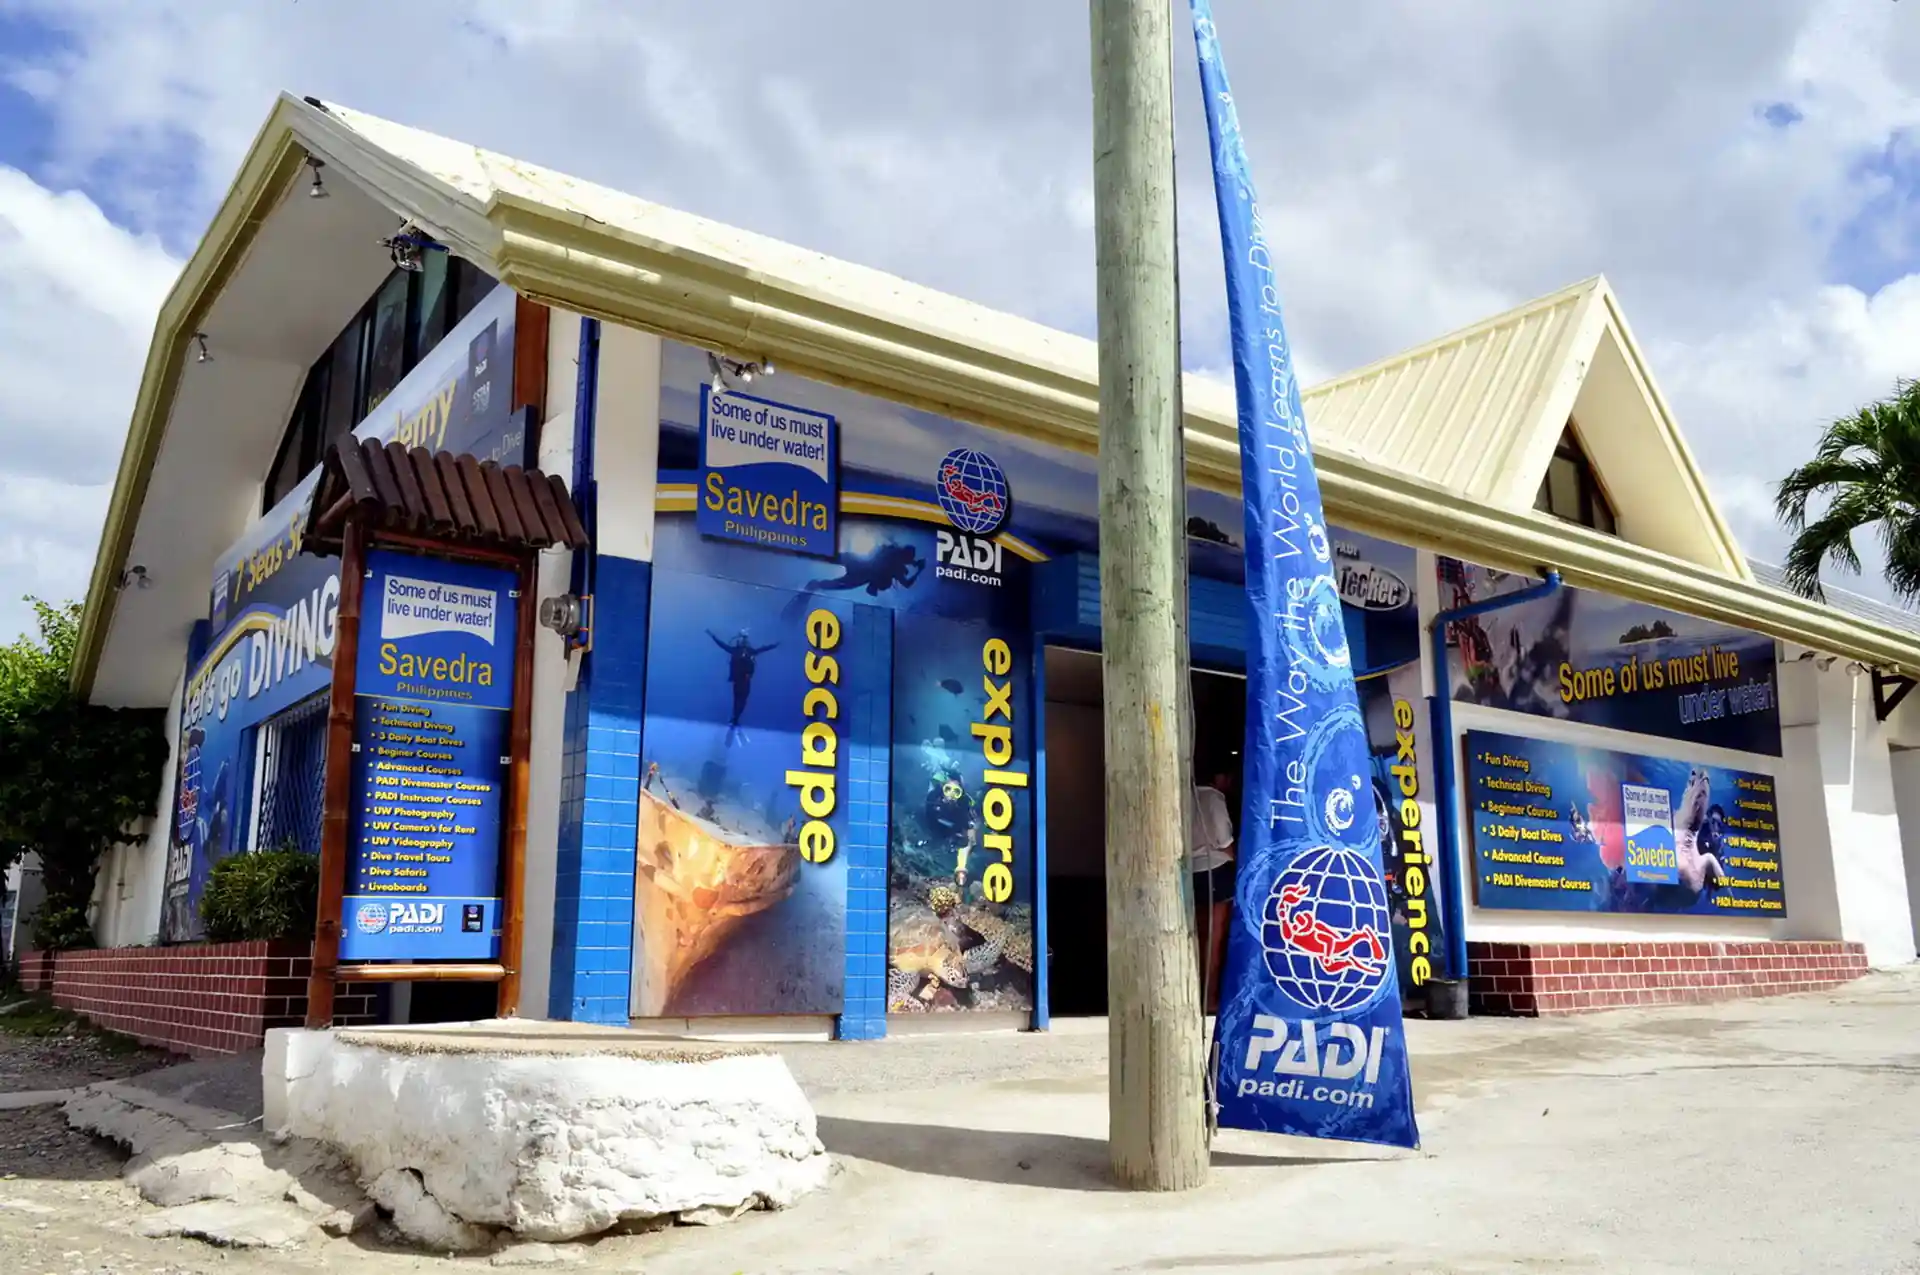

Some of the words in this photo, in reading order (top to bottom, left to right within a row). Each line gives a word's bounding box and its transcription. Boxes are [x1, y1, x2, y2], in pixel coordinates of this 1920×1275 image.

[1260, 285, 1281, 316] to
[1265, 327, 1292, 433] Learns
[712, 396, 751, 422] Some
[754, 408, 769, 426] of
[770, 415, 787, 430] us
[790, 418, 824, 439] must
[712, 418, 736, 442] live
[740, 430, 780, 452] under
[783, 442, 825, 460] water!
[705, 472, 828, 531] Savedra
[1266, 443, 1303, 560] World
[725, 520, 807, 546] Philippines
[936, 530, 1002, 573] PADI
[234, 556, 245, 603] 7
[248, 538, 284, 592] Seas
[936, 566, 1001, 586] padi.com
[388, 579, 426, 600] Some
[429, 586, 442, 601] of
[444, 591, 458, 604] us
[461, 594, 492, 608] must
[1275, 577, 1307, 634] the
[388, 598, 410, 616] live
[413, 605, 451, 622] under
[454, 612, 492, 628] water!
[219, 659, 242, 721] go
[248, 574, 341, 700] DIVING
[379, 643, 492, 686] Savedra
[1558, 661, 1615, 703] Some
[1620, 655, 1638, 693] of
[1643, 659, 1664, 690] us
[1668, 648, 1710, 686] must
[1712, 646, 1738, 679] live
[396, 682, 472, 700] Philippines
[1276, 642, 1315, 743] Way
[1678, 683, 1726, 725] under
[381, 703, 398, 712] Fun
[401, 704, 430, 716] Diving
[380, 717, 422, 728] Technical
[424, 722, 454, 732] Diving
[785, 607, 841, 864] escape
[380, 732, 386, 740] 3
[389, 733, 412, 744] Daily
[416, 735, 436, 744] Boat
[440, 738, 464, 746] Dives
[416, 750, 452, 760] Courses
[1485, 752, 1500, 764] Fun
[1503, 754, 1530, 772] Diving
[376, 763, 424, 772] Advanced
[426, 765, 462, 776] Courses
[970, 637, 1029, 904] explore
[376, 776, 398, 785] PADI
[401, 778, 452, 789] Divemaster
[456, 782, 490, 792] Courses
[1270, 757, 1307, 830] The
[1486, 776, 1524, 791] Technical
[1525, 781, 1551, 798] Diving
[374, 792, 398, 800] PADI
[400, 793, 442, 803] Instructor
[446, 796, 482, 806] Courses
[1527, 804, 1558, 818] Courses
[374, 806, 392, 814] UW
[394, 808, 456, 820] Photography
[372, 822, 391, 830] UW
[393, 822, 436, 832] Camera's
[439, 824, 452, 832] for
[455, 826, 476, 834] Rent
[1490, 825, 1496, 836] 3
[1498, 825, 1520, 842] Daily
[1521, 828, 1540, 840] Boat
[1541, 829, 1562, 842] Dives
[372, 836, 390, 844] UW
[393, 837, 454, 850] Videography
[1390, 699, 1432, 986] experience
[1628, 840, 1676, 868] Savedra
[370, 852, 392, 860] Dive
[395, 852, 424, 861] Travel
[426, 854, 450, 862] Tours
[1492, 849, 1532, 863] Advanced
[1534, 852, 1564, 866] Courses
[369, 867, 392, 876] Dive
[394, 868, 427, 876] Safaris
[1493, 874, 1514, 886] PADI
[1514, 874, 1559, 888] Divemaster
[1560, 876, 1591, 890] Courses
[368, 882, 428, 892] Liveaboards
[390, 903, 445, 924] PADI
[390, 925, 442, 934] padi.com
[1244, 1014, 1385, 1084] PADI
[1237, 1079, 1374, 1110] padi.com
